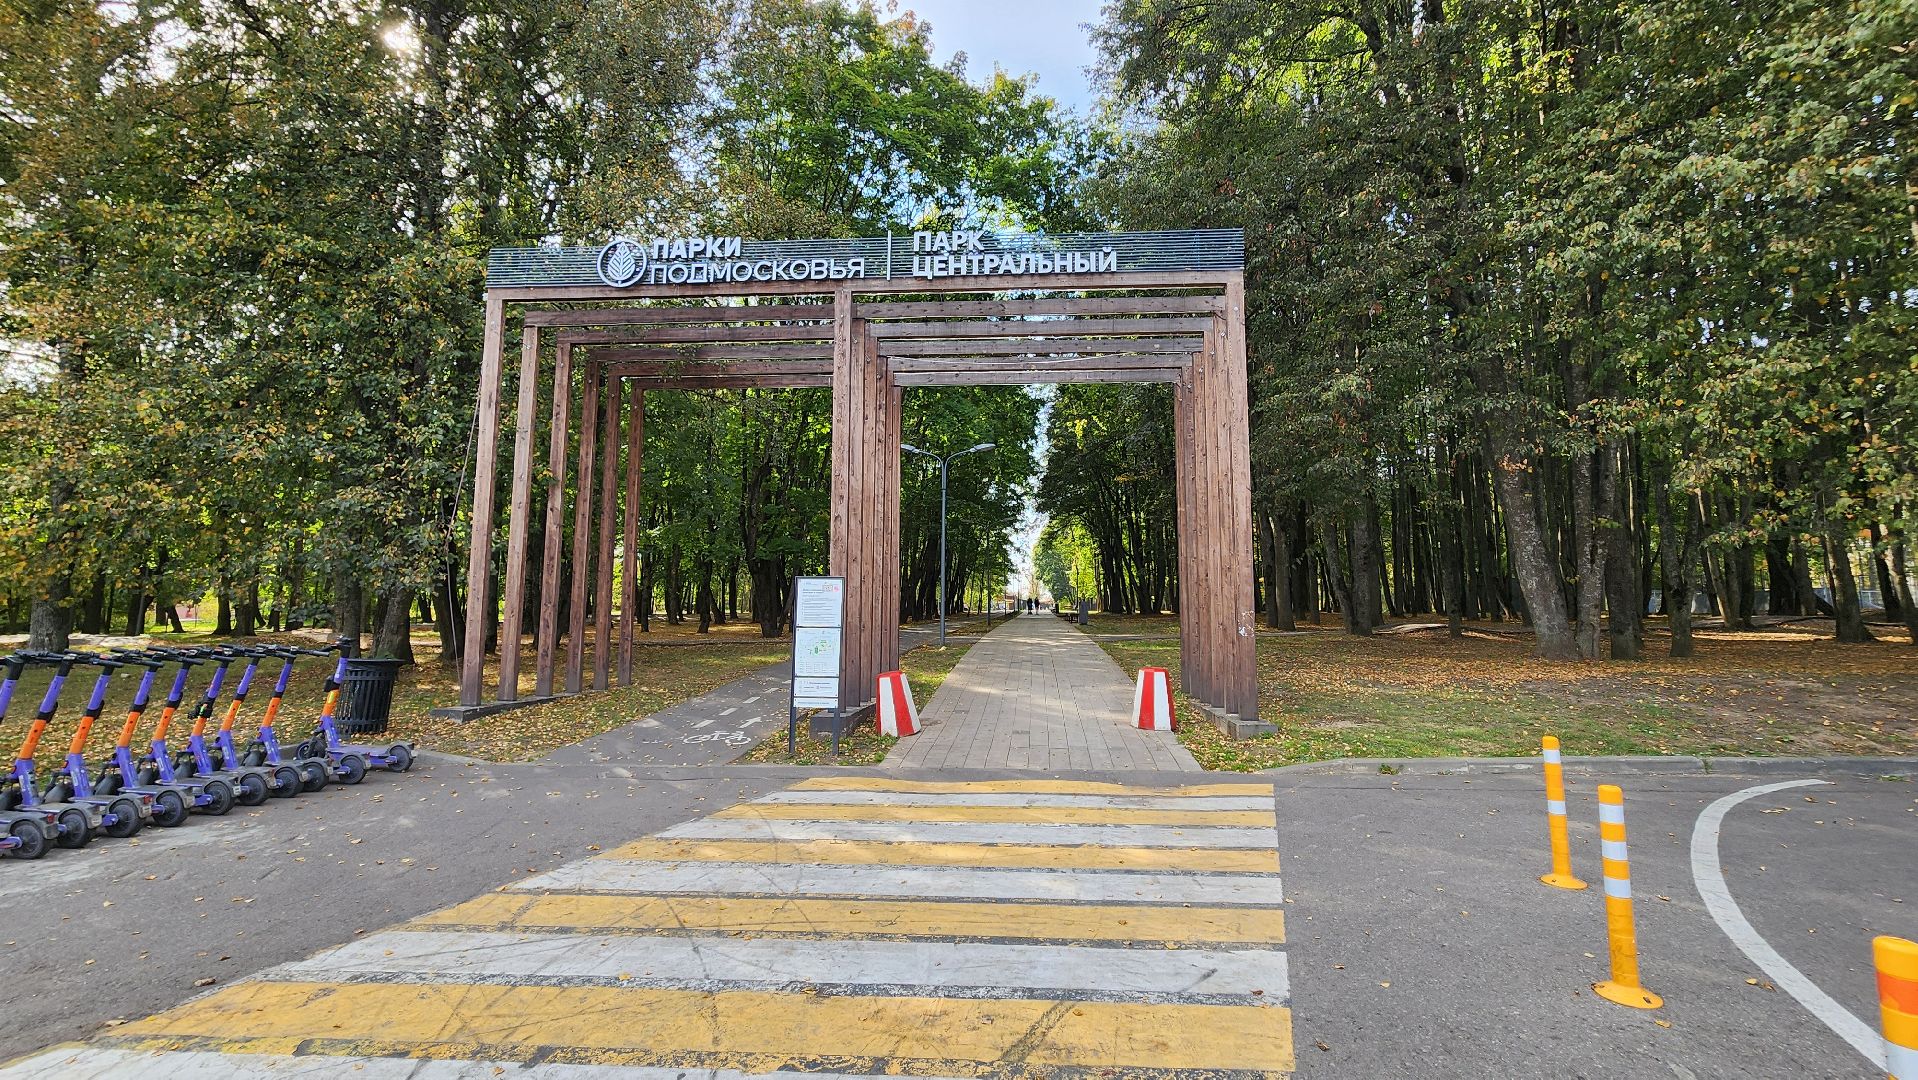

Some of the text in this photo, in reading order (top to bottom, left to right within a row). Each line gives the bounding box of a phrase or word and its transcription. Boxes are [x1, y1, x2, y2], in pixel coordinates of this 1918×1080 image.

[652, 236, 742, 259] ПАРКИ
[913, 230, 986, 252] ПАРК
[650, 257, 866, 285] ПОДМОСКОВЬЯ
[912, 246, 1118, 280] ЦЕНТРАЛЬНЫЙ
